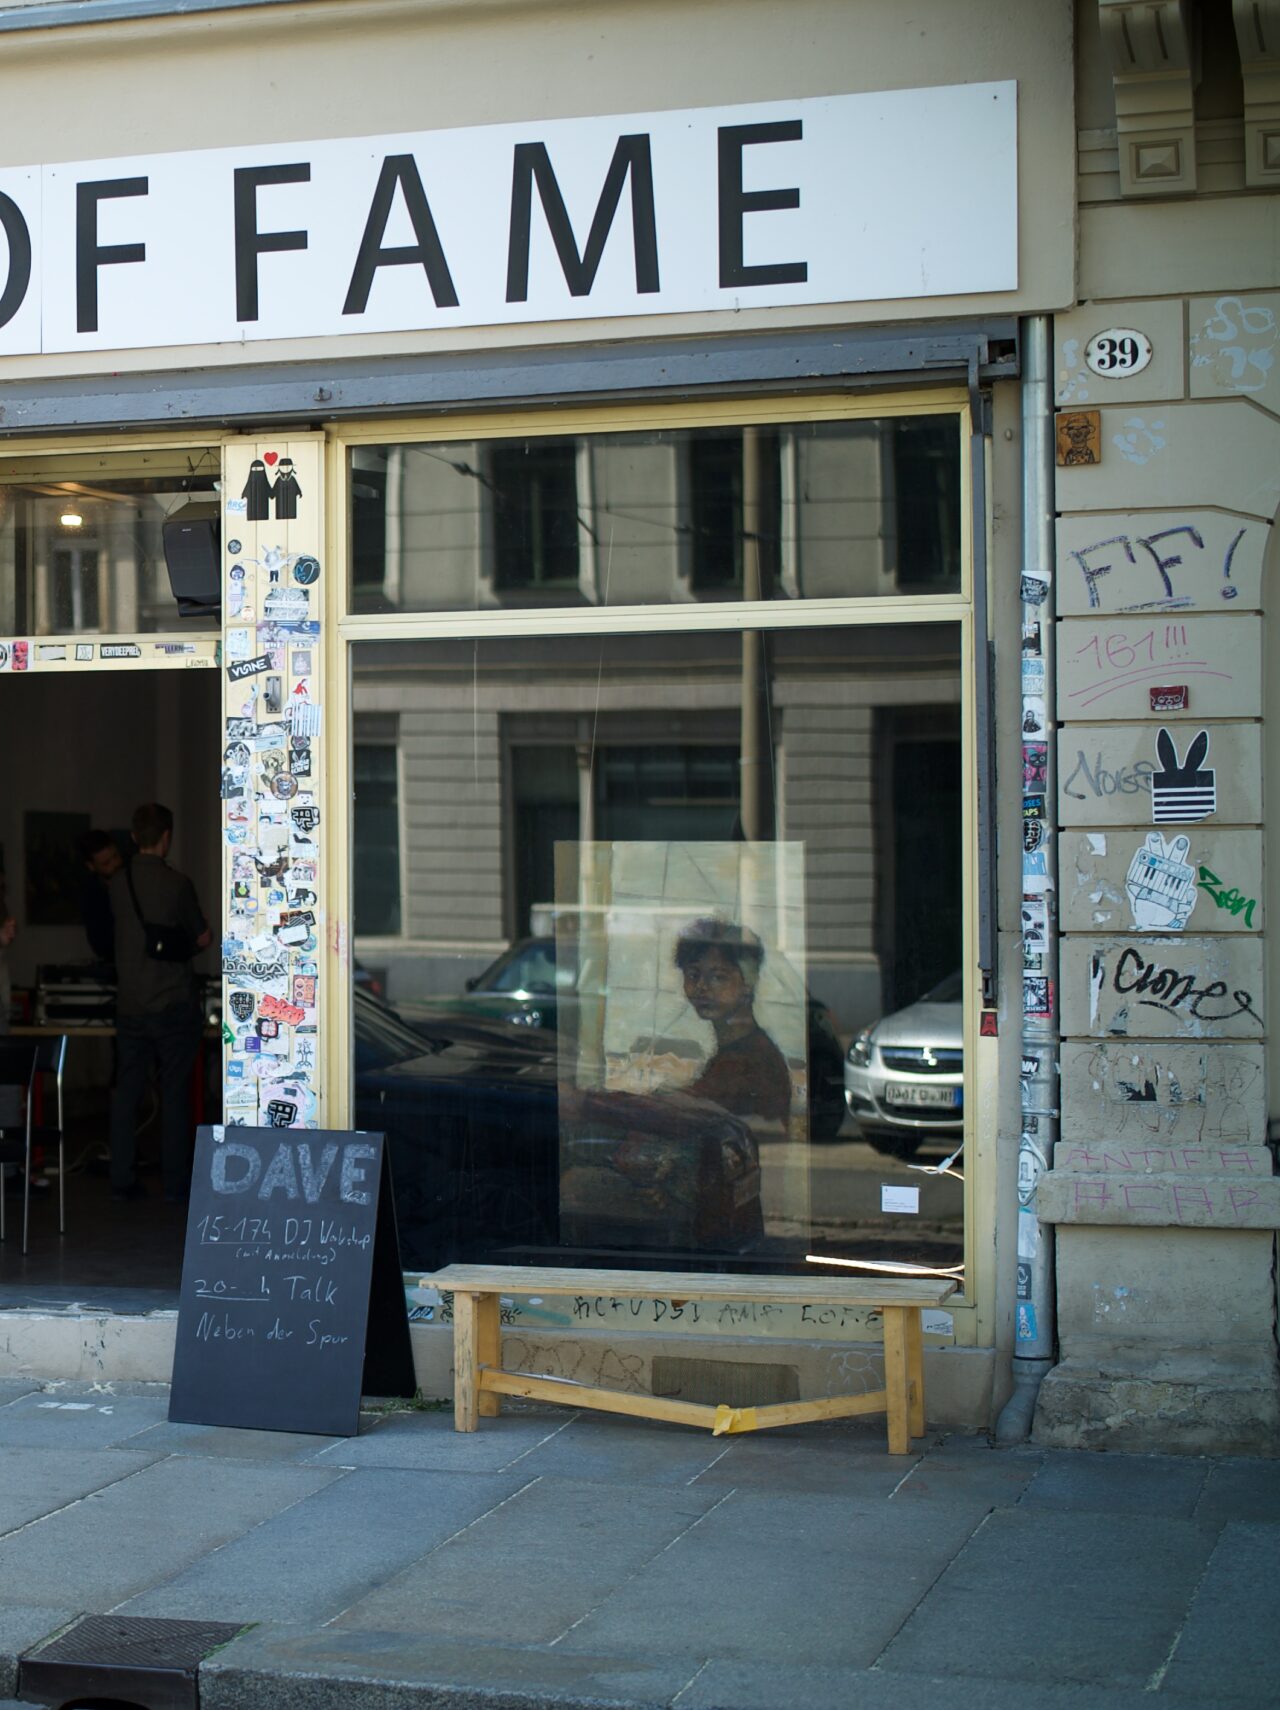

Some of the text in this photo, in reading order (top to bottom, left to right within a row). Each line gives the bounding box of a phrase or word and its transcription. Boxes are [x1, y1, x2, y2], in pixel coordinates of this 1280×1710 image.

[234, 119, 808, 322] FAME
[1097, 337, 1139, 370] 39
[210, 1143, 377, 1206] DAVE
[284, 1218, 312, 1245] DJ
[283, 1275, 338, 1305] Talk
[196, 1311, 351, 1350] Neben der Spur
